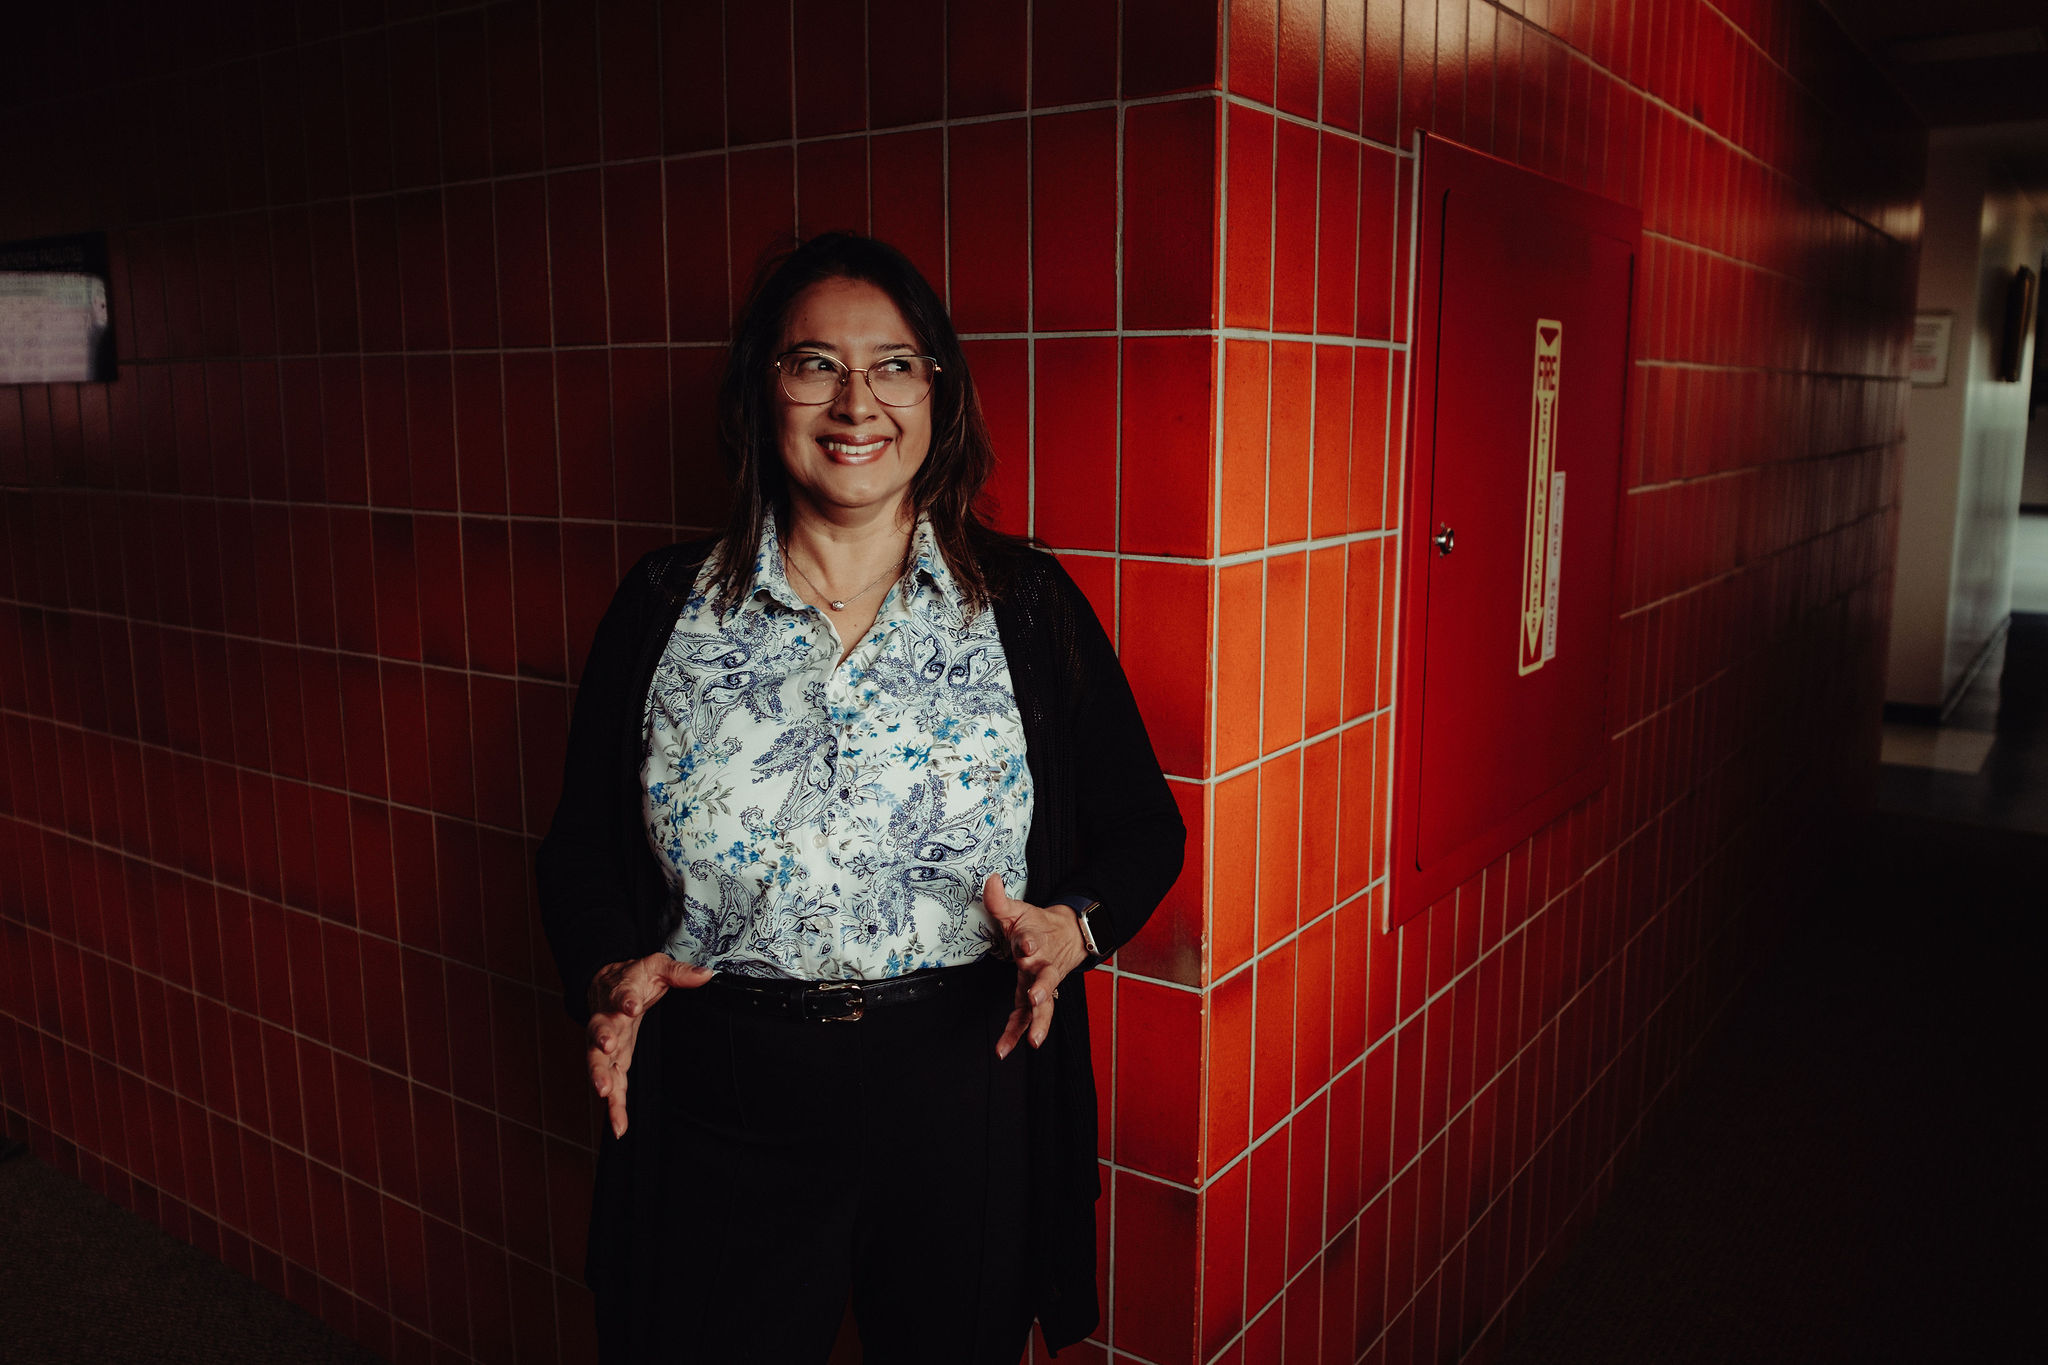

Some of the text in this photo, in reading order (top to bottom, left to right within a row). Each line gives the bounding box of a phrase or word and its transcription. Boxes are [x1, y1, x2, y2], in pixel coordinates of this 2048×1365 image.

[1537, 355, 1556, 391] FIRE
[1531, 398, 1548, 632] EXTINGUISHER
[1548, 486, 1561, 646] FIRE HOSE
